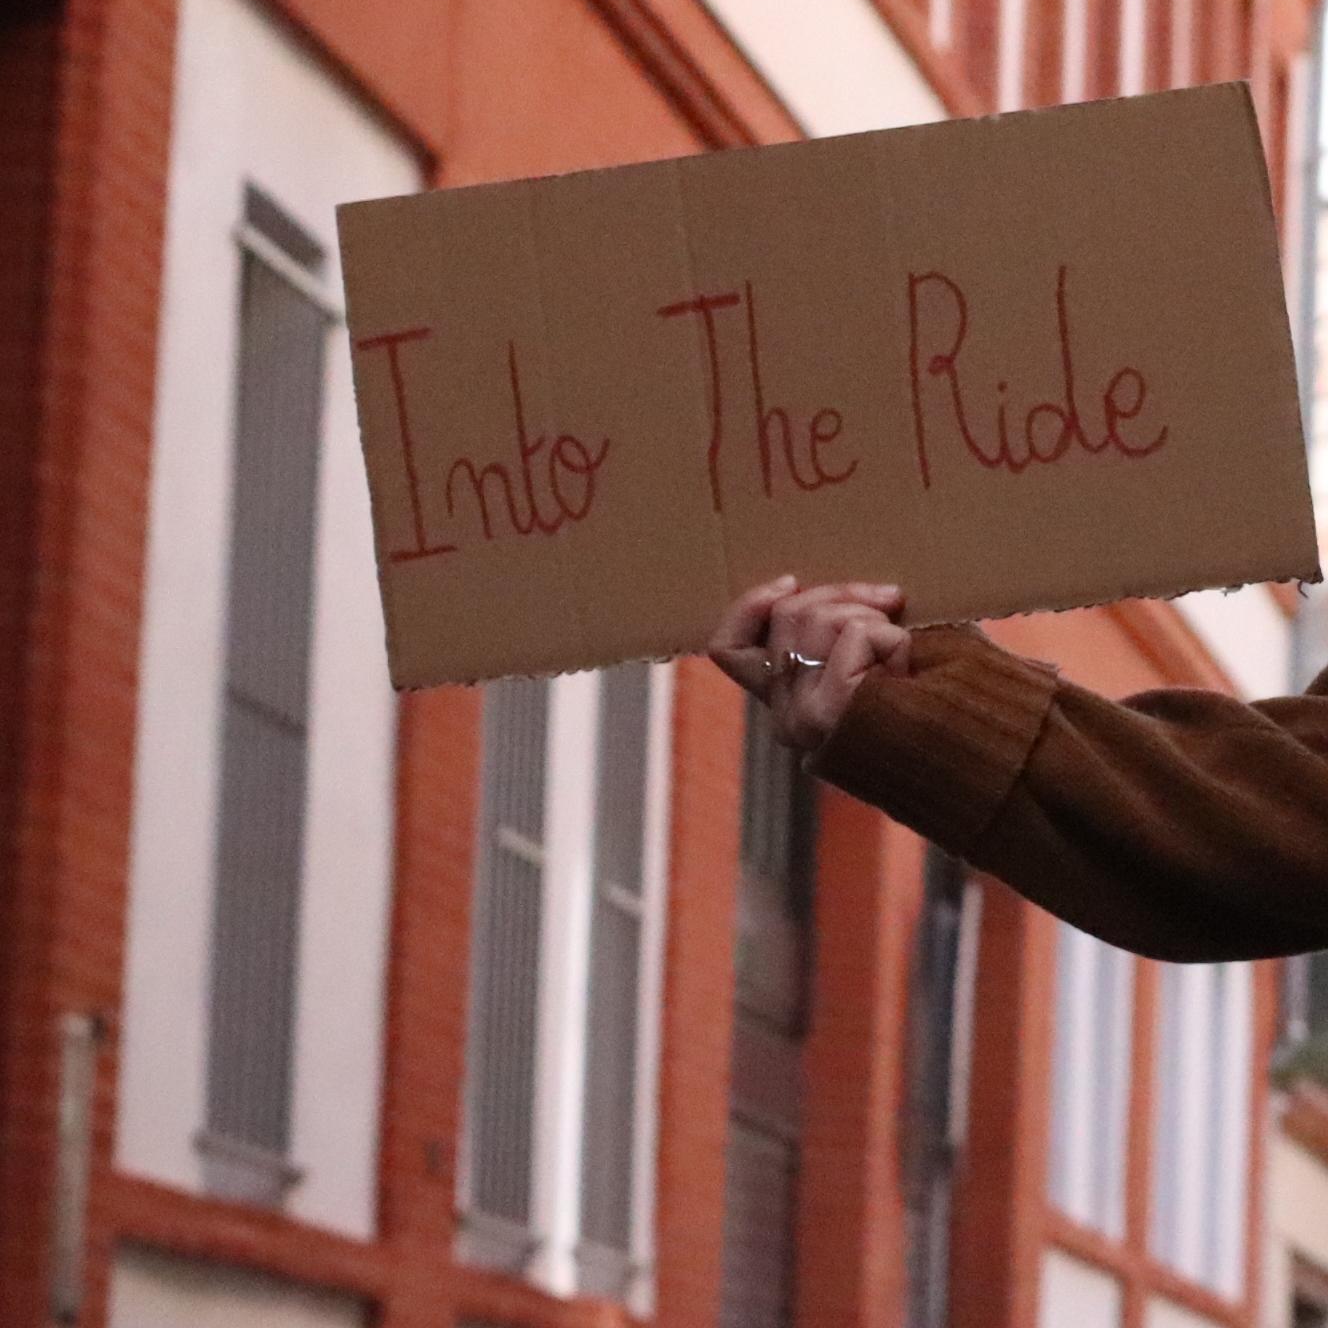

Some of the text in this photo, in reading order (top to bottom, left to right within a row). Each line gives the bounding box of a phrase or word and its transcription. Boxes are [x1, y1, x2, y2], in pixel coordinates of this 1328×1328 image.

[356, 265, 1167, 562] Into The Ride
